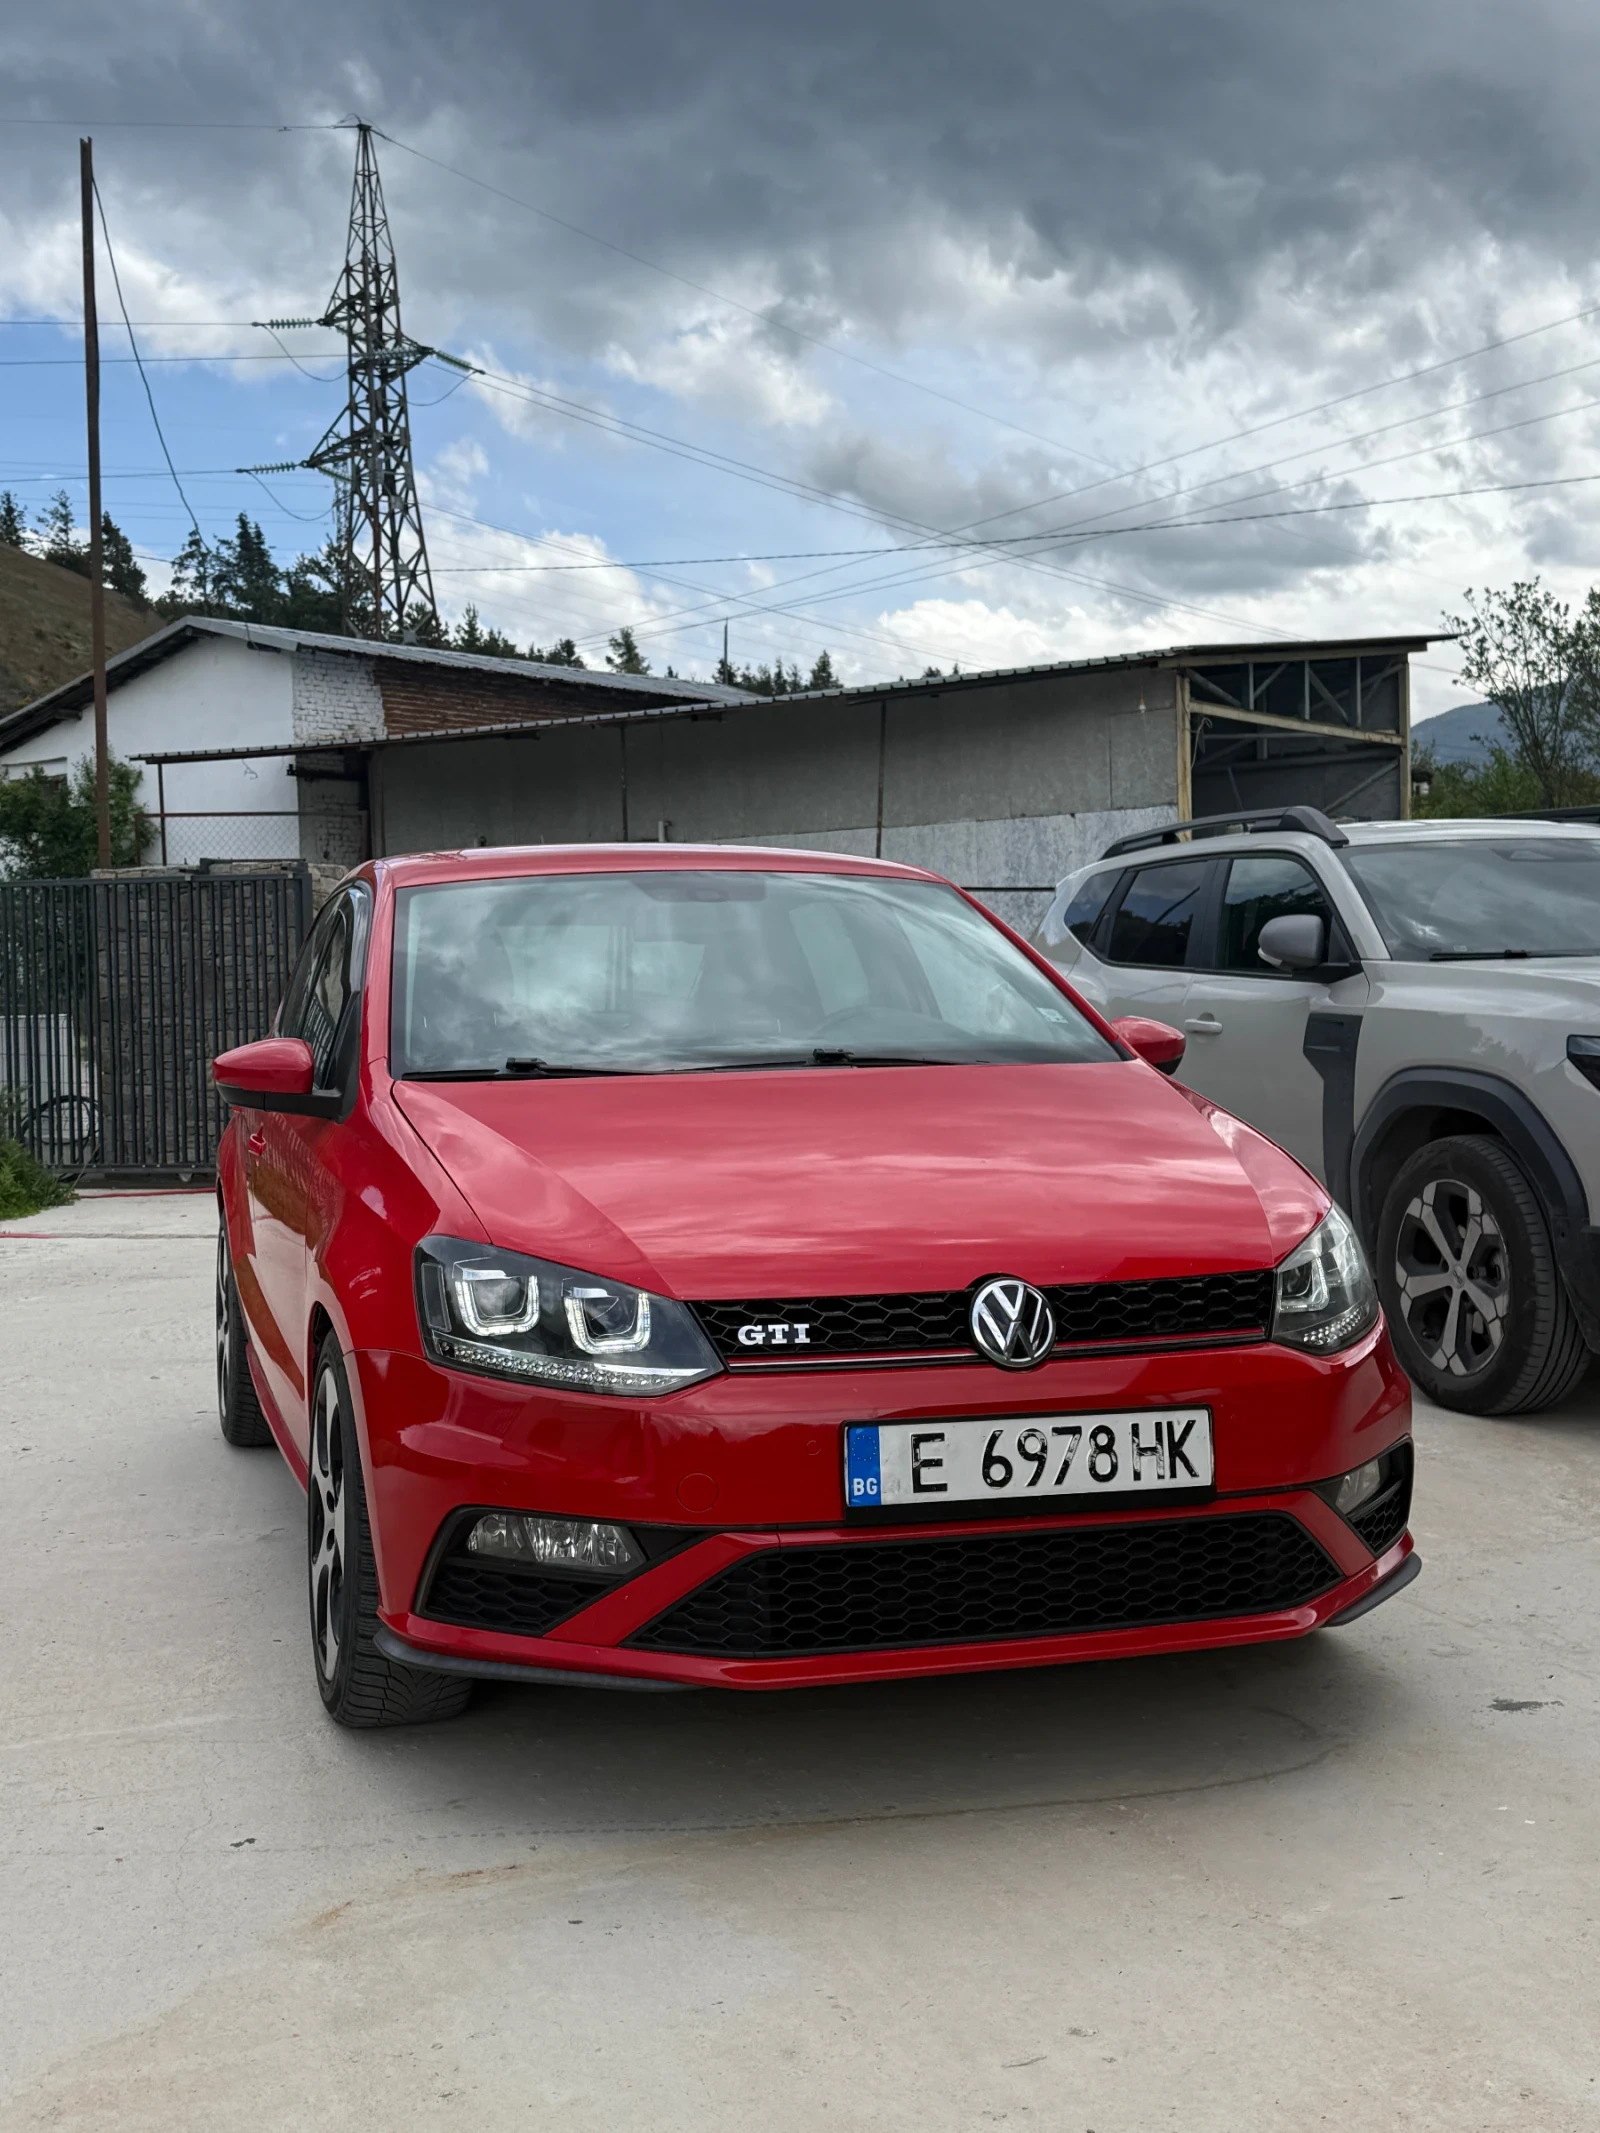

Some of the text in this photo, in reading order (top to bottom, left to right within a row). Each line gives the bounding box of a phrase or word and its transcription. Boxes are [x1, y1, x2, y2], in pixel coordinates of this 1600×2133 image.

[738, 1324, 811, 1345] GTI
[911, 1420, 1199, 1493] E 6978 HK
[853, 1478, 878, 1496] BG
